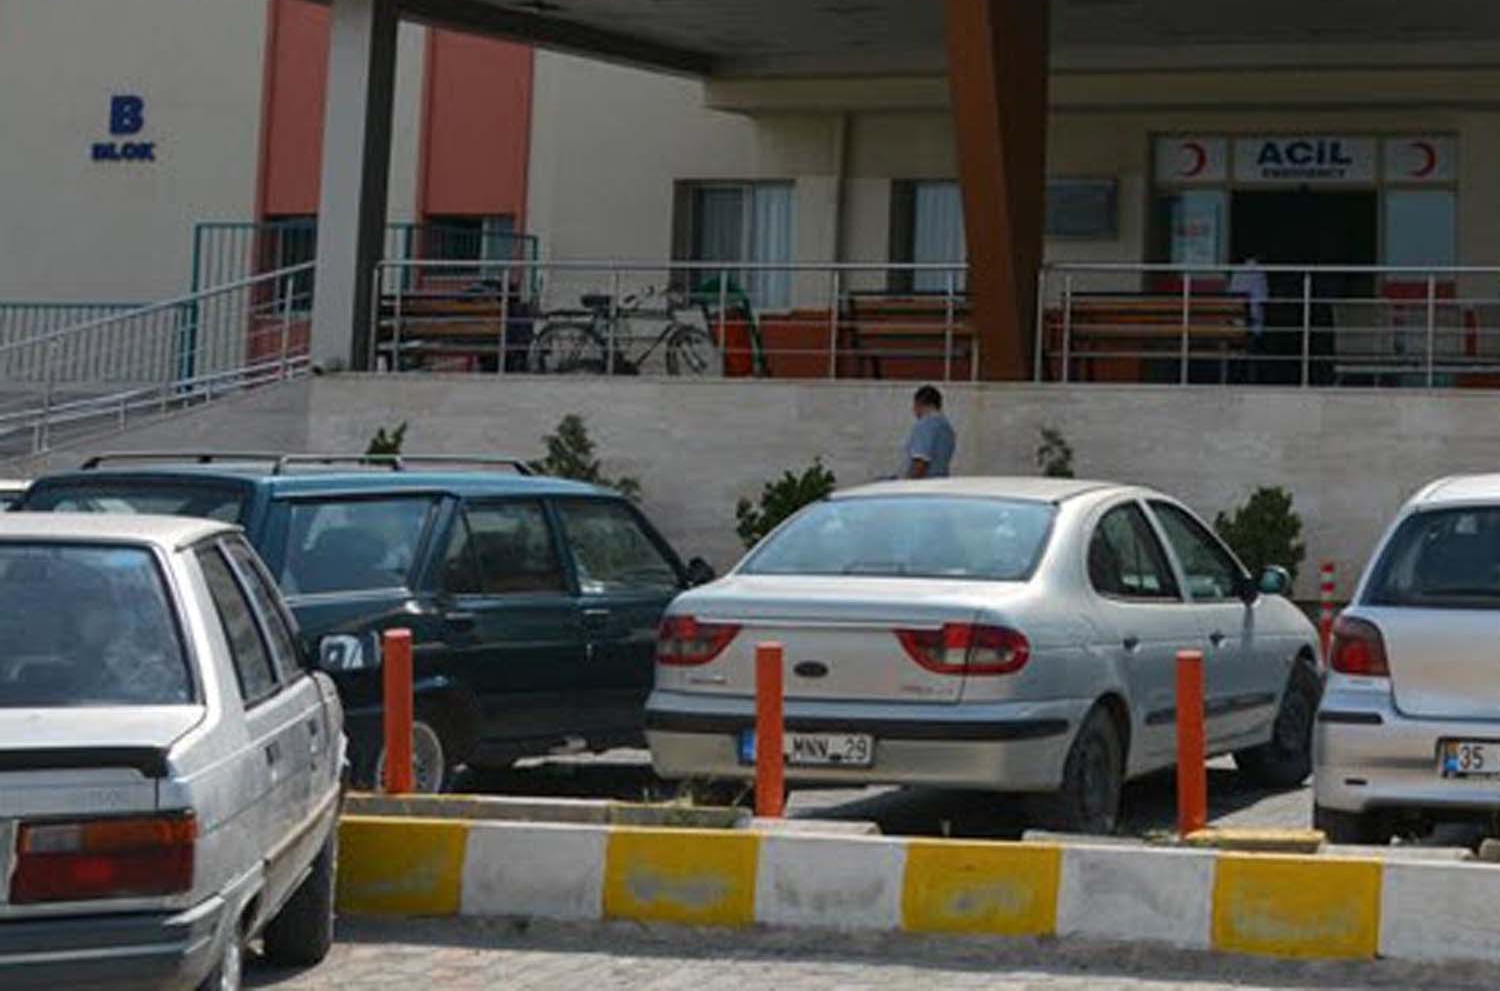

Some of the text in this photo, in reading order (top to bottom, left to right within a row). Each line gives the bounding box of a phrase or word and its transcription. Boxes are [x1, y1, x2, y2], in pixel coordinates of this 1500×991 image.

[110, 95, 144, 135] B
[91, 142, 156, 161] BLOK
[1459, 745, 1484, 770] 35
